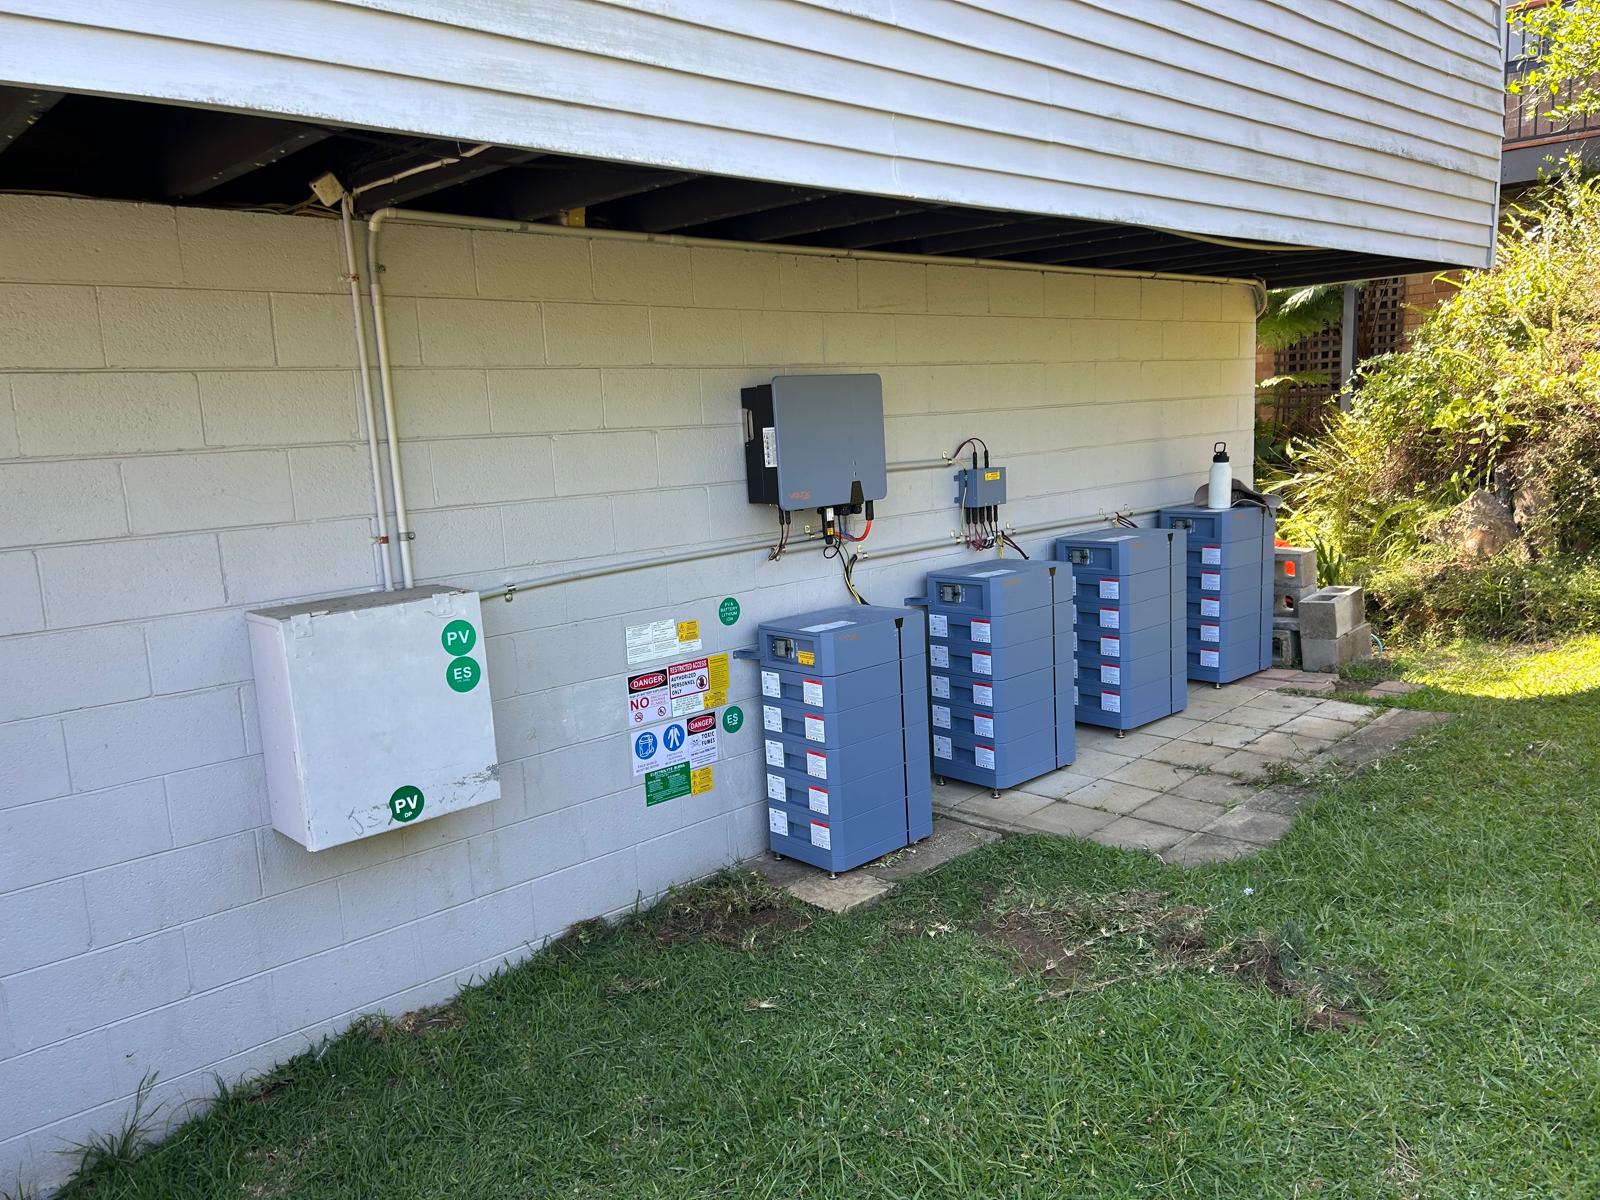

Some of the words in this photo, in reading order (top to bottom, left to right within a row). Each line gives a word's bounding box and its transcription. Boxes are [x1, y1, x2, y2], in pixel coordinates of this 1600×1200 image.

[447, 629, 469, 646] PV
[670, 663, 692, 674] RESTRICTED
[692, 660, 707, 669] ACCESS
[453, 667, 472, 680] ES
[671, 672, 696, 682] AUTHORIZED
[633, 675, 663, 688] DANGER
[671, 680, 695, 688] PERSONNEL
[630, 697, 650, 711] NO
[690, 718, 713, 729] DANGER
[727, 713, 738, 724] ES
[701, 731, 715, 739] TOXIC
[701, 738, 716, 746] FUMES
[394, 795, 418, 813] PV
